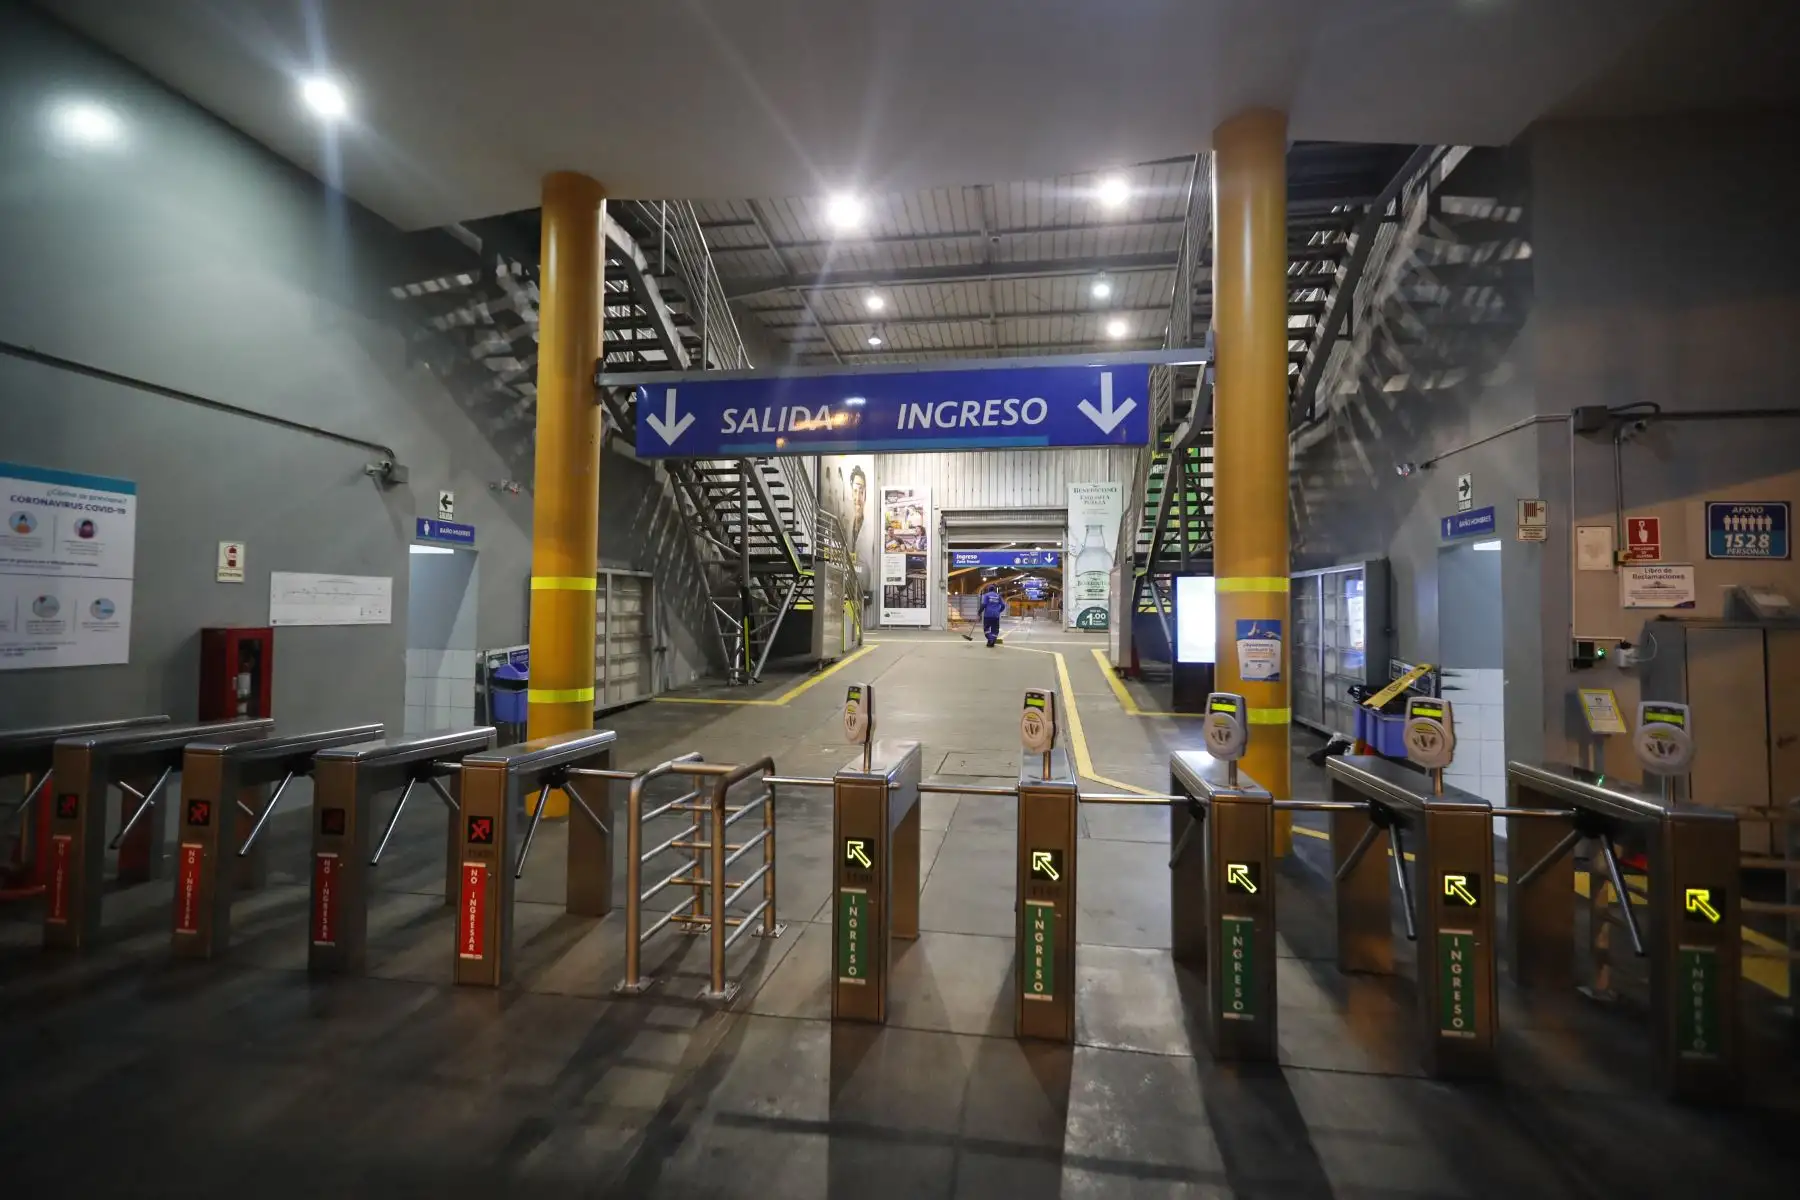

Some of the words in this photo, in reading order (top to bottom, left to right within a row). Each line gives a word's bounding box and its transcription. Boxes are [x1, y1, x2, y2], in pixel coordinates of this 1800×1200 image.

[720, 404, 833, 434] SALIDA
[897, 397, 1048, 430] INGRESO
[10, 494, 83, 510] CORONAVIRUS
[84, 503, 127, 515] COVID-19
[1731, 506, 1765, 514] AFORO
[1724, 533, 1770, 548] 1528
[956, 553, 978, 561] Ingreso
[1726, 547, 1770, 556] PERSONAS
[1644, 567, 1662, 575] Libro
[1663, 567, 1673, 575] de
[188, 849, 196, 864] NO
[323, 858, 331, 874] NO
[470, 868, 478, 884] NO
[468, 891, 477, 952] INGRESAR
[848, 895, 858, 976] INGRESO
[1033, 907, 1044, 992] INGRESO
[1232, 923, 1244, 1010] INGRESO
[1450, 936, 1464, 1028] INGRESO
